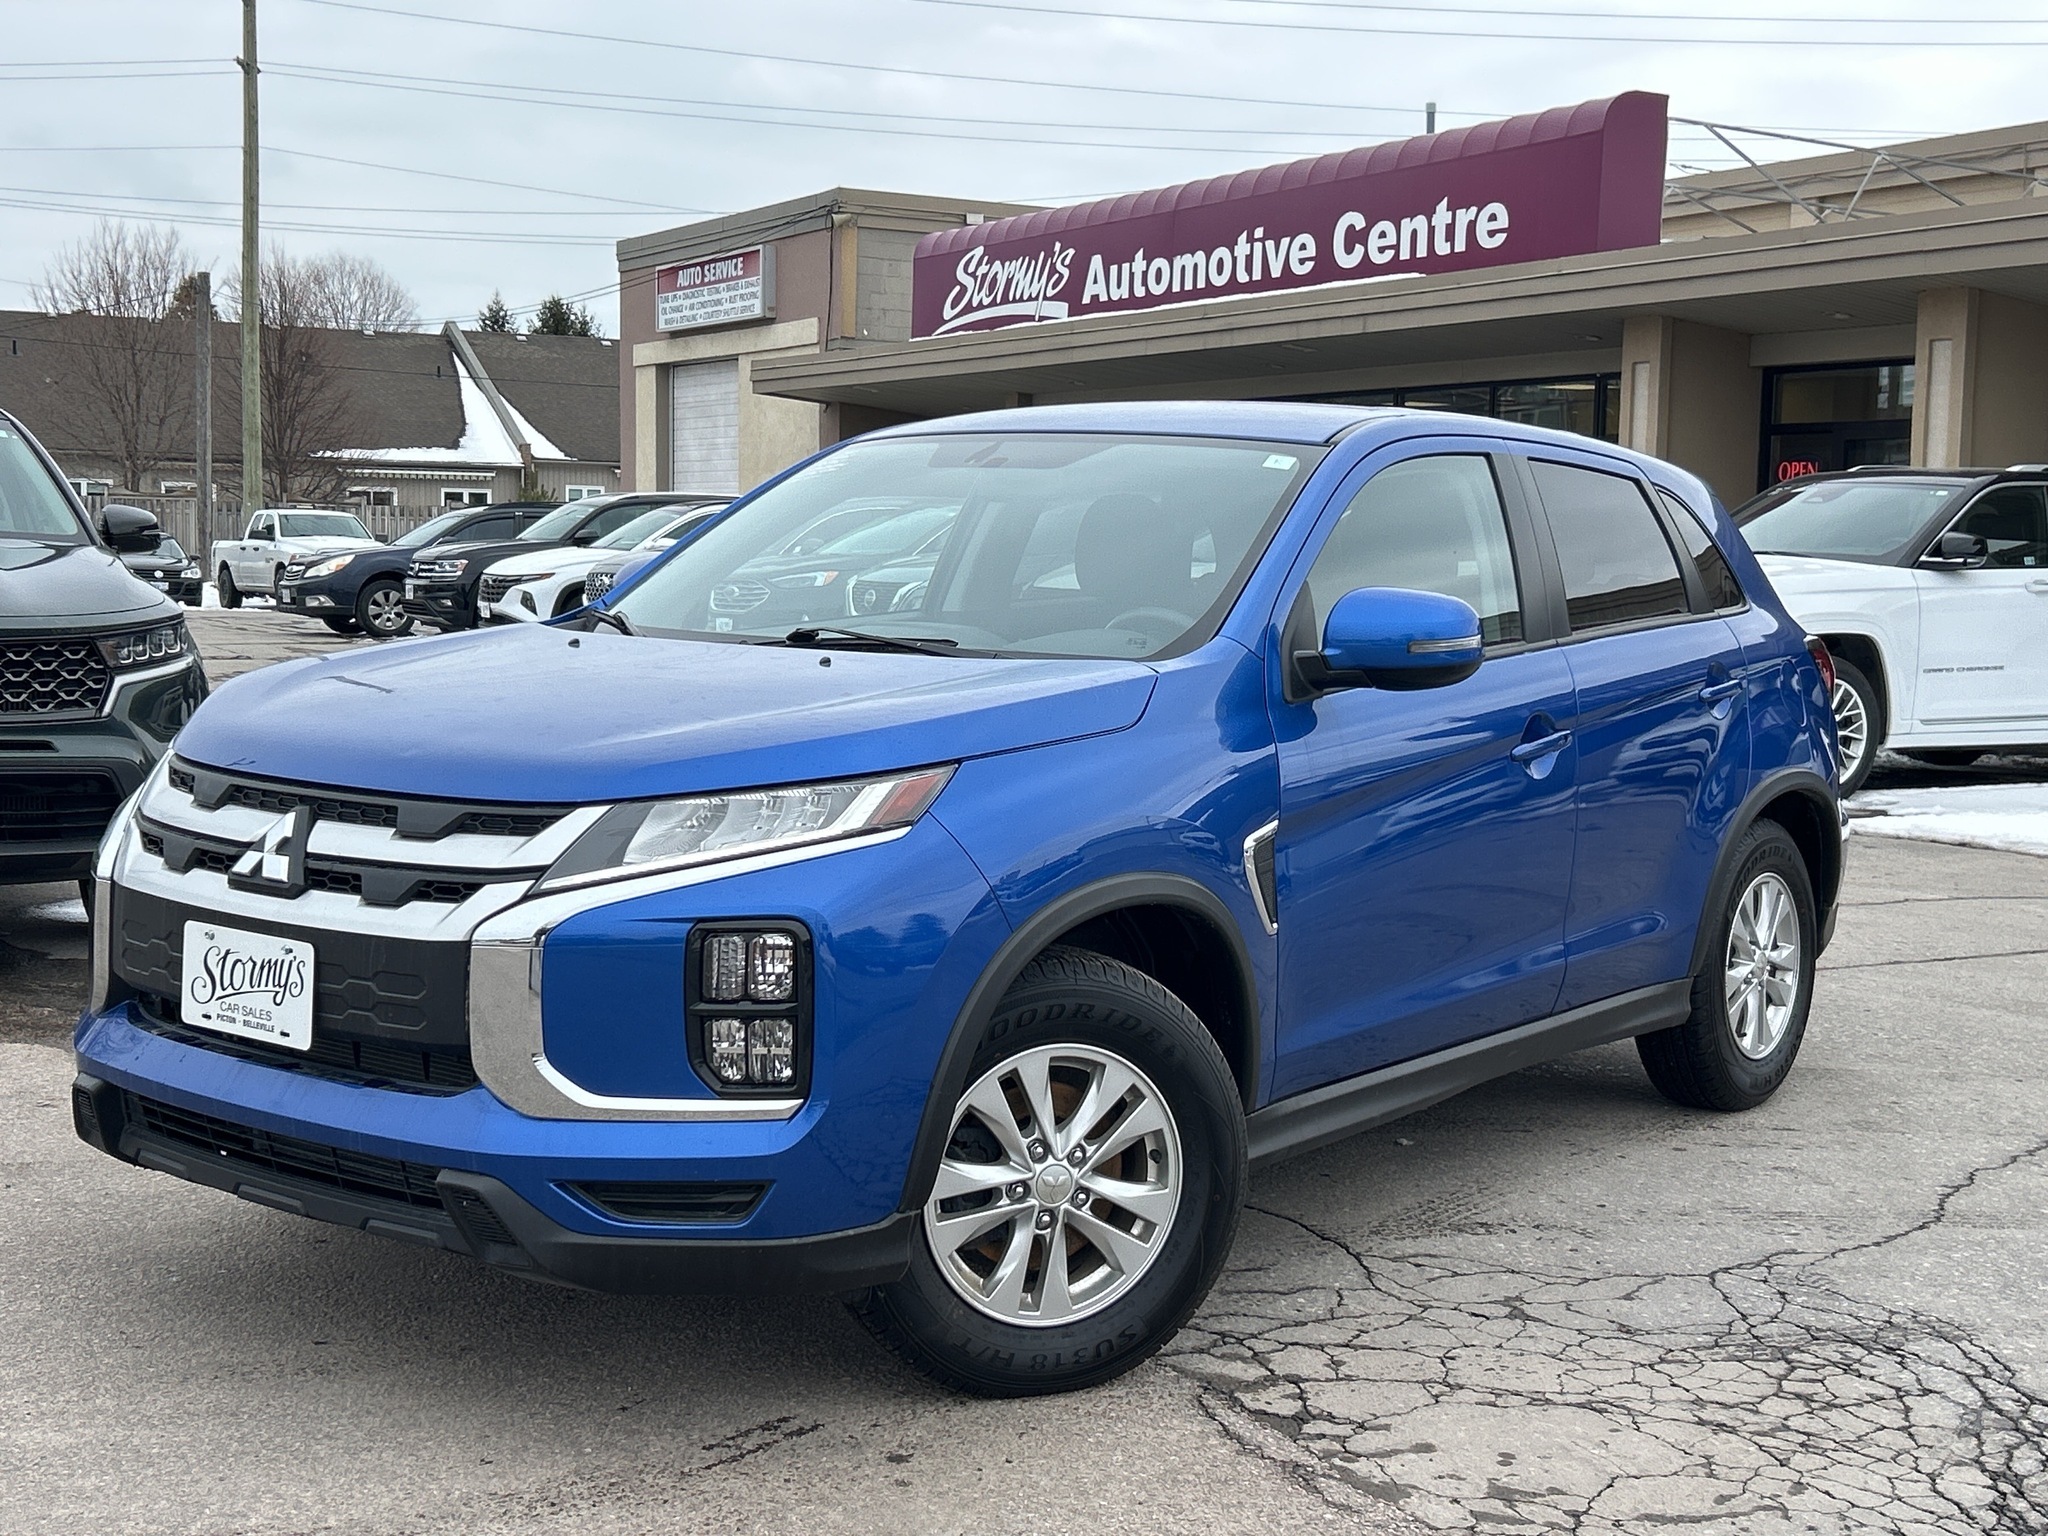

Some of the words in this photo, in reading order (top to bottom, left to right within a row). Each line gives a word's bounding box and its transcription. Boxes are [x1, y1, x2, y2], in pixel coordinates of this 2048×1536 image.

[676, 266, 702, 288] AUTO
[704, 257, 744, 283] SERVICE
[942, 240, 1076, 322] Stormy's
[1081, 227, 1316, 304] Automotive
[1333, 196, 1509, 265] Centre
[1779, 462, 1818, 481] OPEN
[191, 945, 305, 1007] Stormy's
[216, 1013, 237, 1025] PICTON
[243, 1019, 275, 1033] BELLEVILLE
[220, 1001, 240, 1014] CAR
[241, 1005, 273, 1022] SALES
[976, 1002, 1164, 1056] OODRIDE
[952, 1337, 1016, 1370] H/T
[1030, 1324, 1138, 1370] SU318
